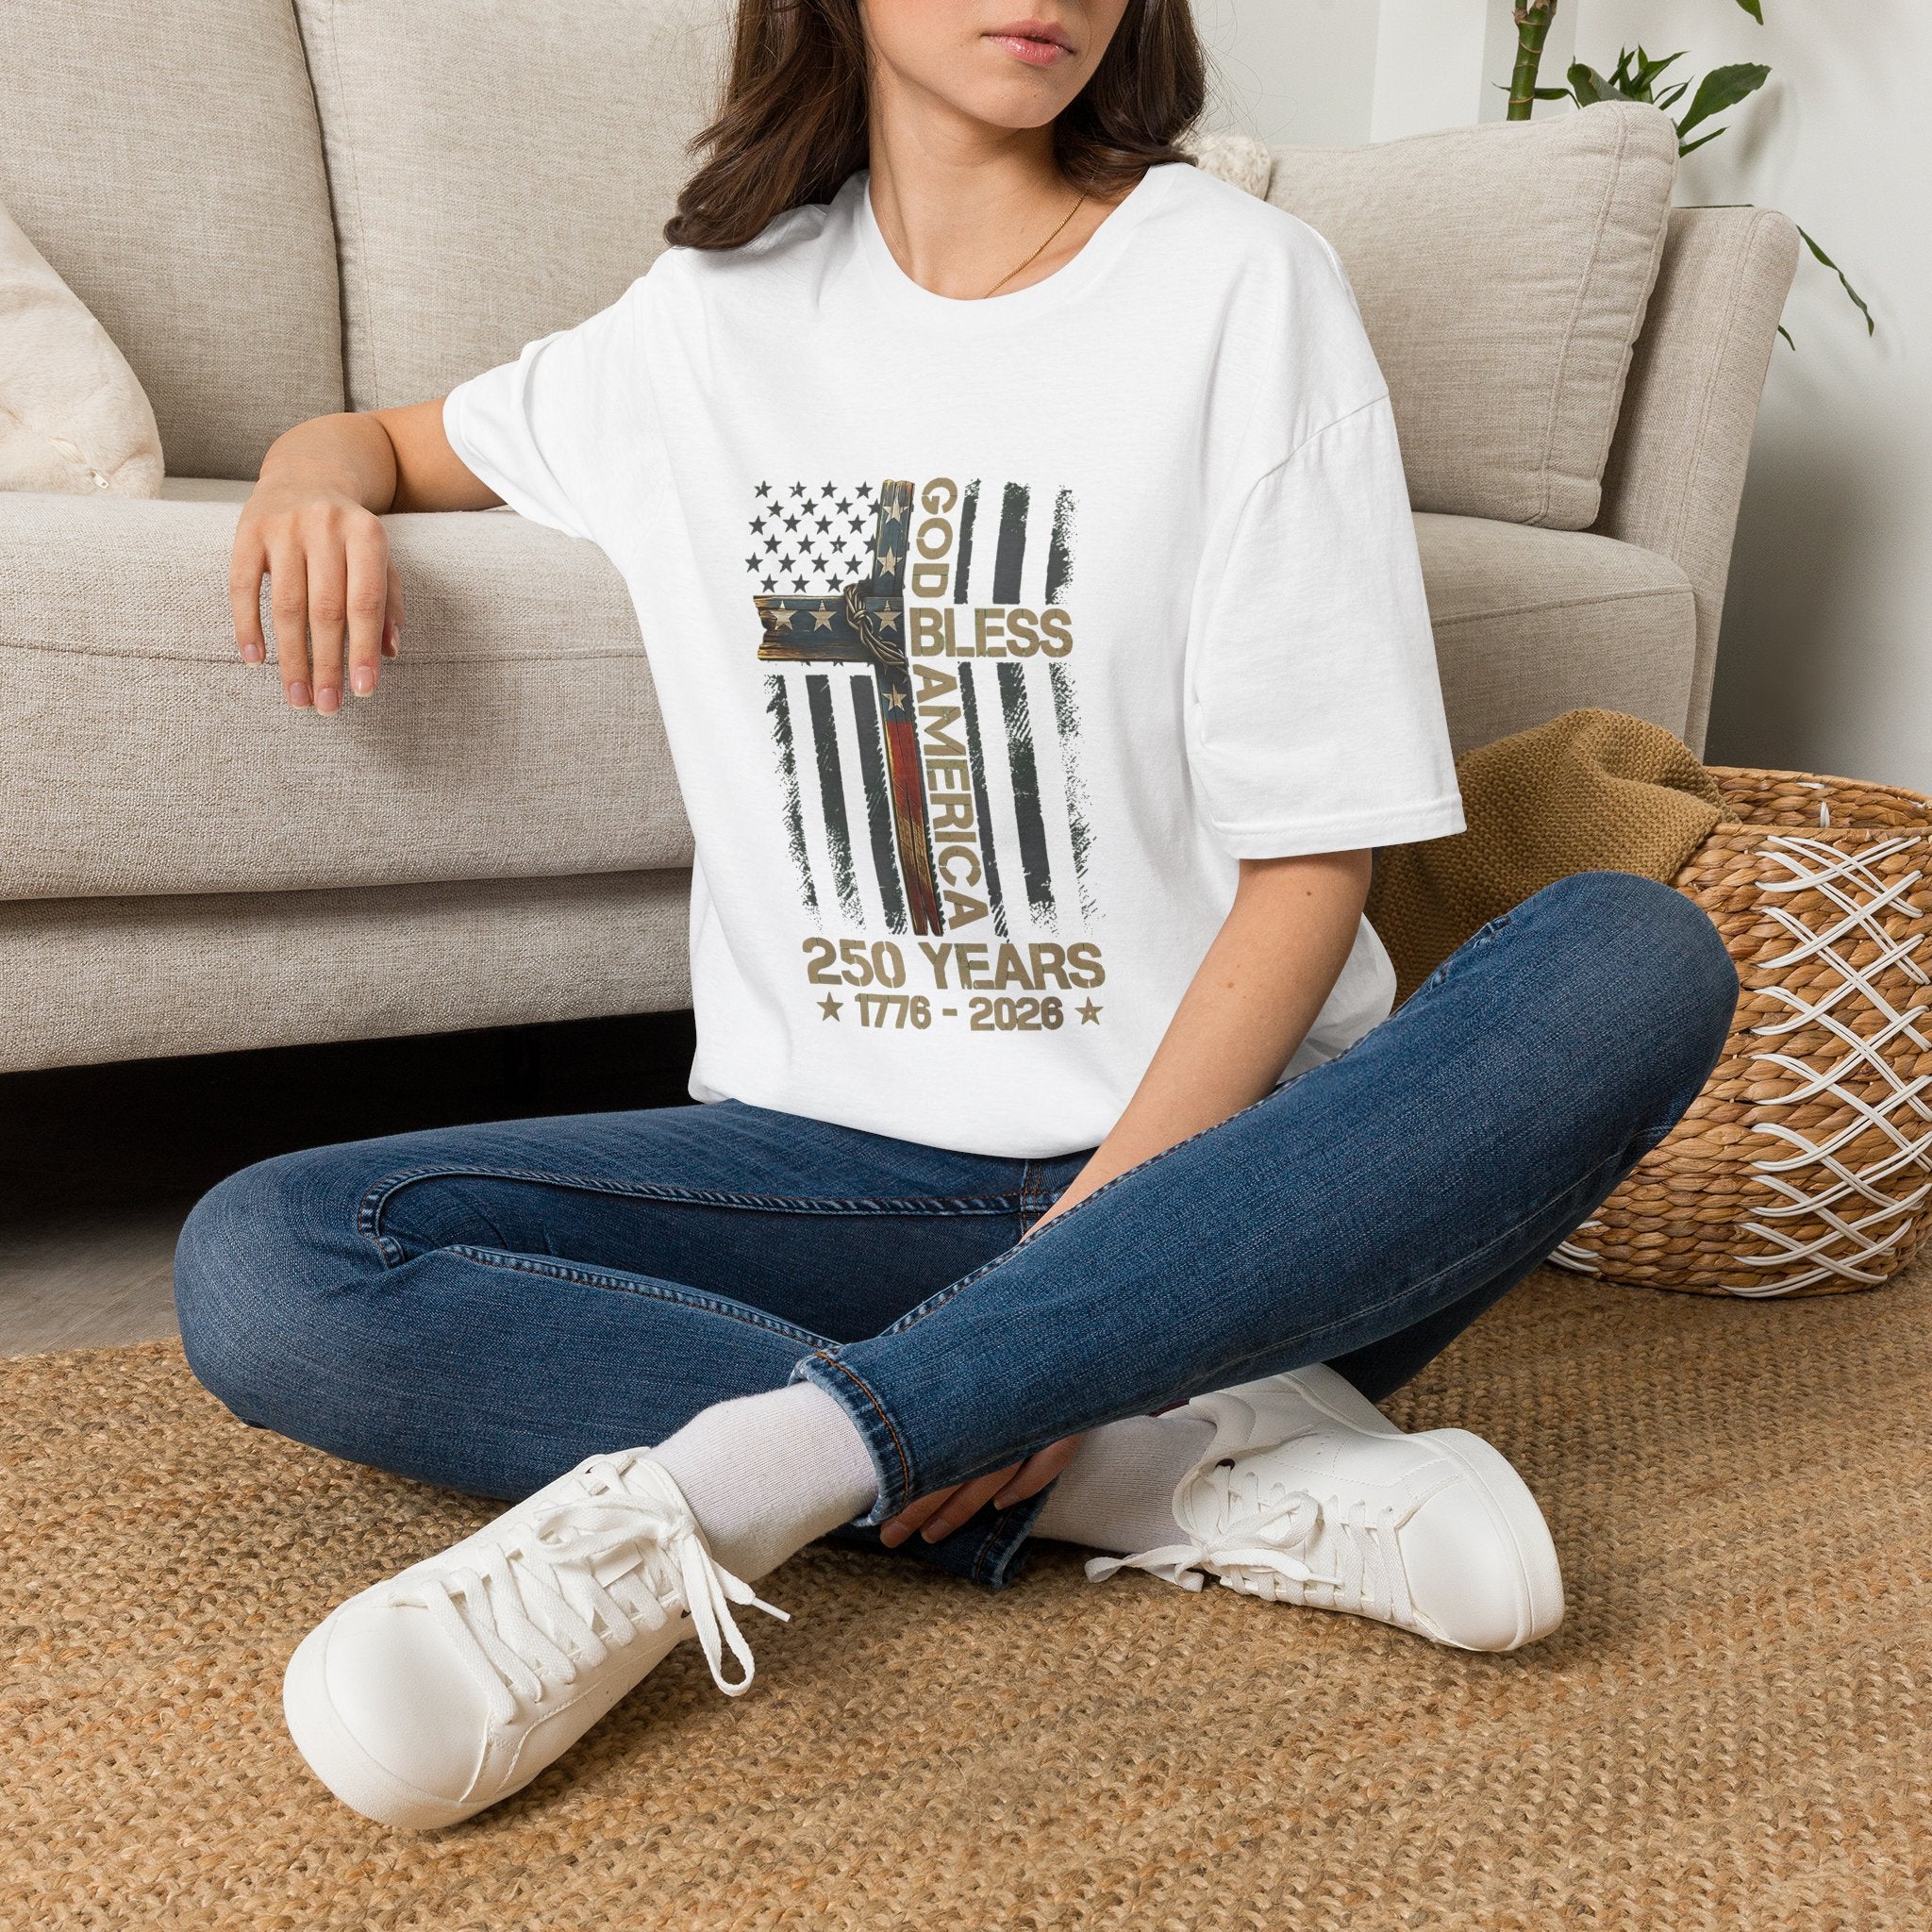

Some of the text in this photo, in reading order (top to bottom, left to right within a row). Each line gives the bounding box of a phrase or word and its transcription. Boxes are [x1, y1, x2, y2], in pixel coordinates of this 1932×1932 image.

[911, 476, 958, 598] GOD
[910, 607, 1074, 658] BLESS
[913, 663, 990, 931] AMERICA
[802, 937, 1107, 990] 250 YEARS
[855, 993, 931, 1029] 1776
[969, 995, 1064, 1031] 2026
